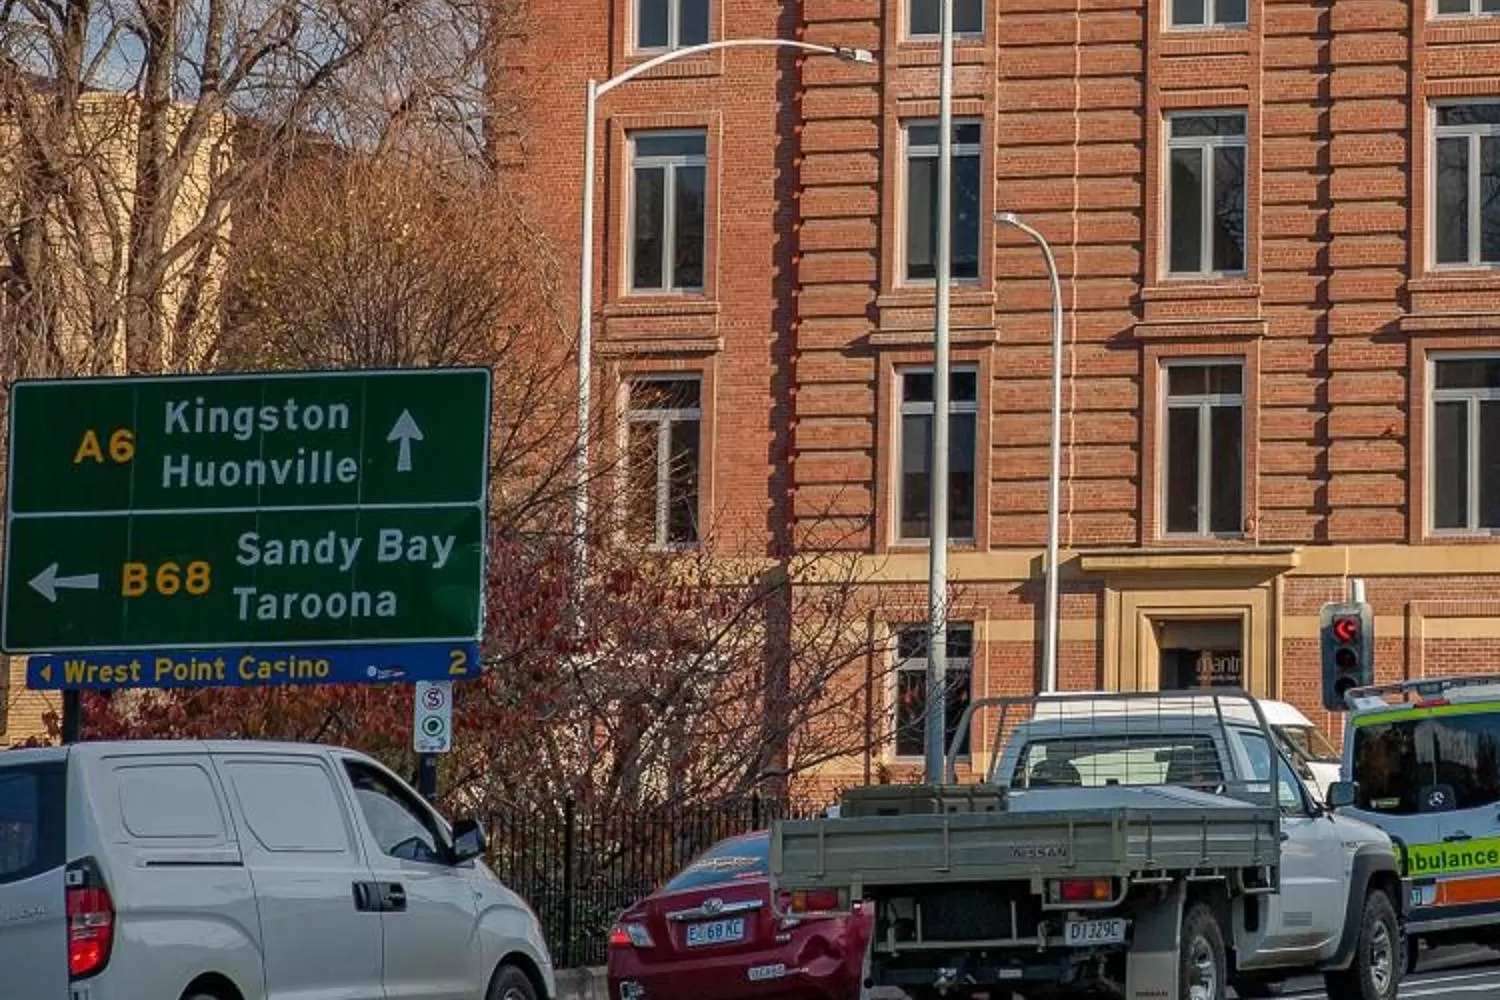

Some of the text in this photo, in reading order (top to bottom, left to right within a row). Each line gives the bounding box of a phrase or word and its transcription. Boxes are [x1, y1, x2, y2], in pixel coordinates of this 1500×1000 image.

[164, 398, 350, 440] Kingston
[73, 430, 137, 464] A6
[161, 448, 359, 488] Huonville
[236, 528, 457, 571] Sandy Bay
[120, 560, 213, 597] B68
[232, 586, 398, 621] Taroona
[63, 660, 141, 684] Wrest
[155, 655, 226, 681] Point
[447, 649, 469, 675] 2
